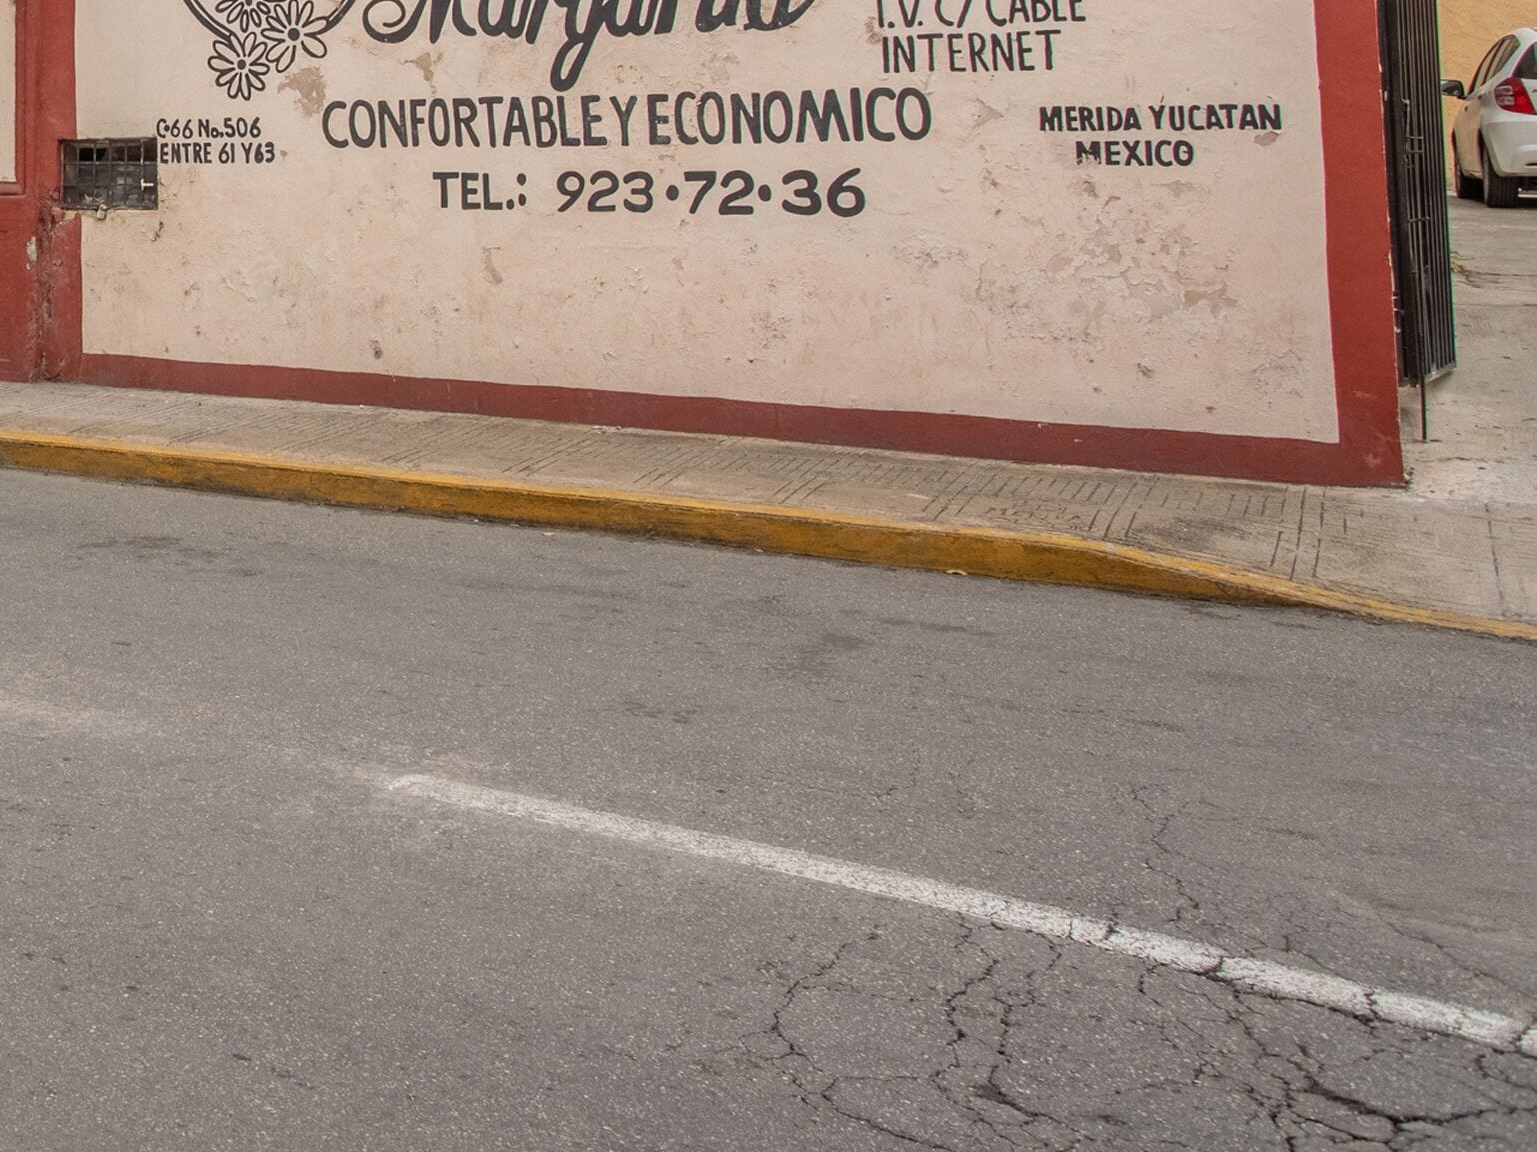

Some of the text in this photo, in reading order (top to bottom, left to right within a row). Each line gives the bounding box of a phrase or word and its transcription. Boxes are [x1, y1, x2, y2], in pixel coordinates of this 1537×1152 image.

[882, 29, 1062, 74] INTERNET
[321, 87, 933, 148] CONFORTABLE Y ECONOMICO
[1039, 103, 1283, 132] MERIDA YUCATAN
[159, 142, 212, 164] ENTRE
[218, 142, 235, 164] 61
[1075, 139, 1194, 167] MEXICO
